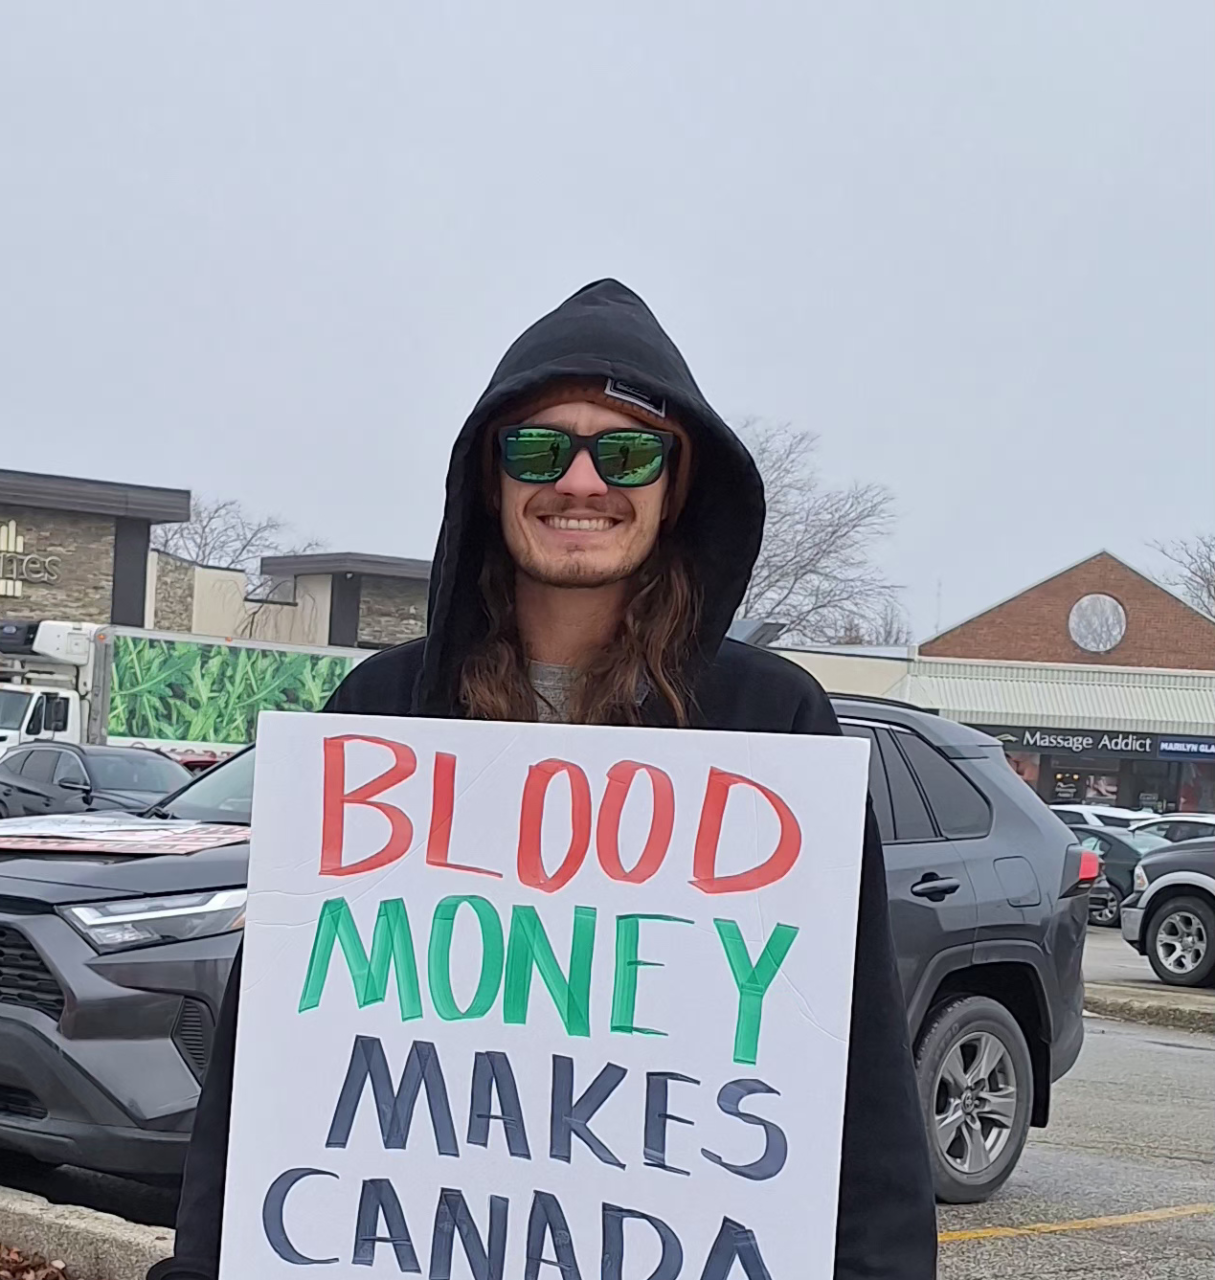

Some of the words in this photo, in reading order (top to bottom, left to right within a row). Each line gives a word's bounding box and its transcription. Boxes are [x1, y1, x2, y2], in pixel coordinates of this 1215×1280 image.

[319, 734, 803, 894] BLOOD
[1023, 730, 1093, 752] Massage
[1098, 734, 1152, 752] Addict
[1159, 741, 1197, 752] MARILYN
[298, 895, 799, 1065] MONEY
[325, 1034, 788, 1181] MAKES
